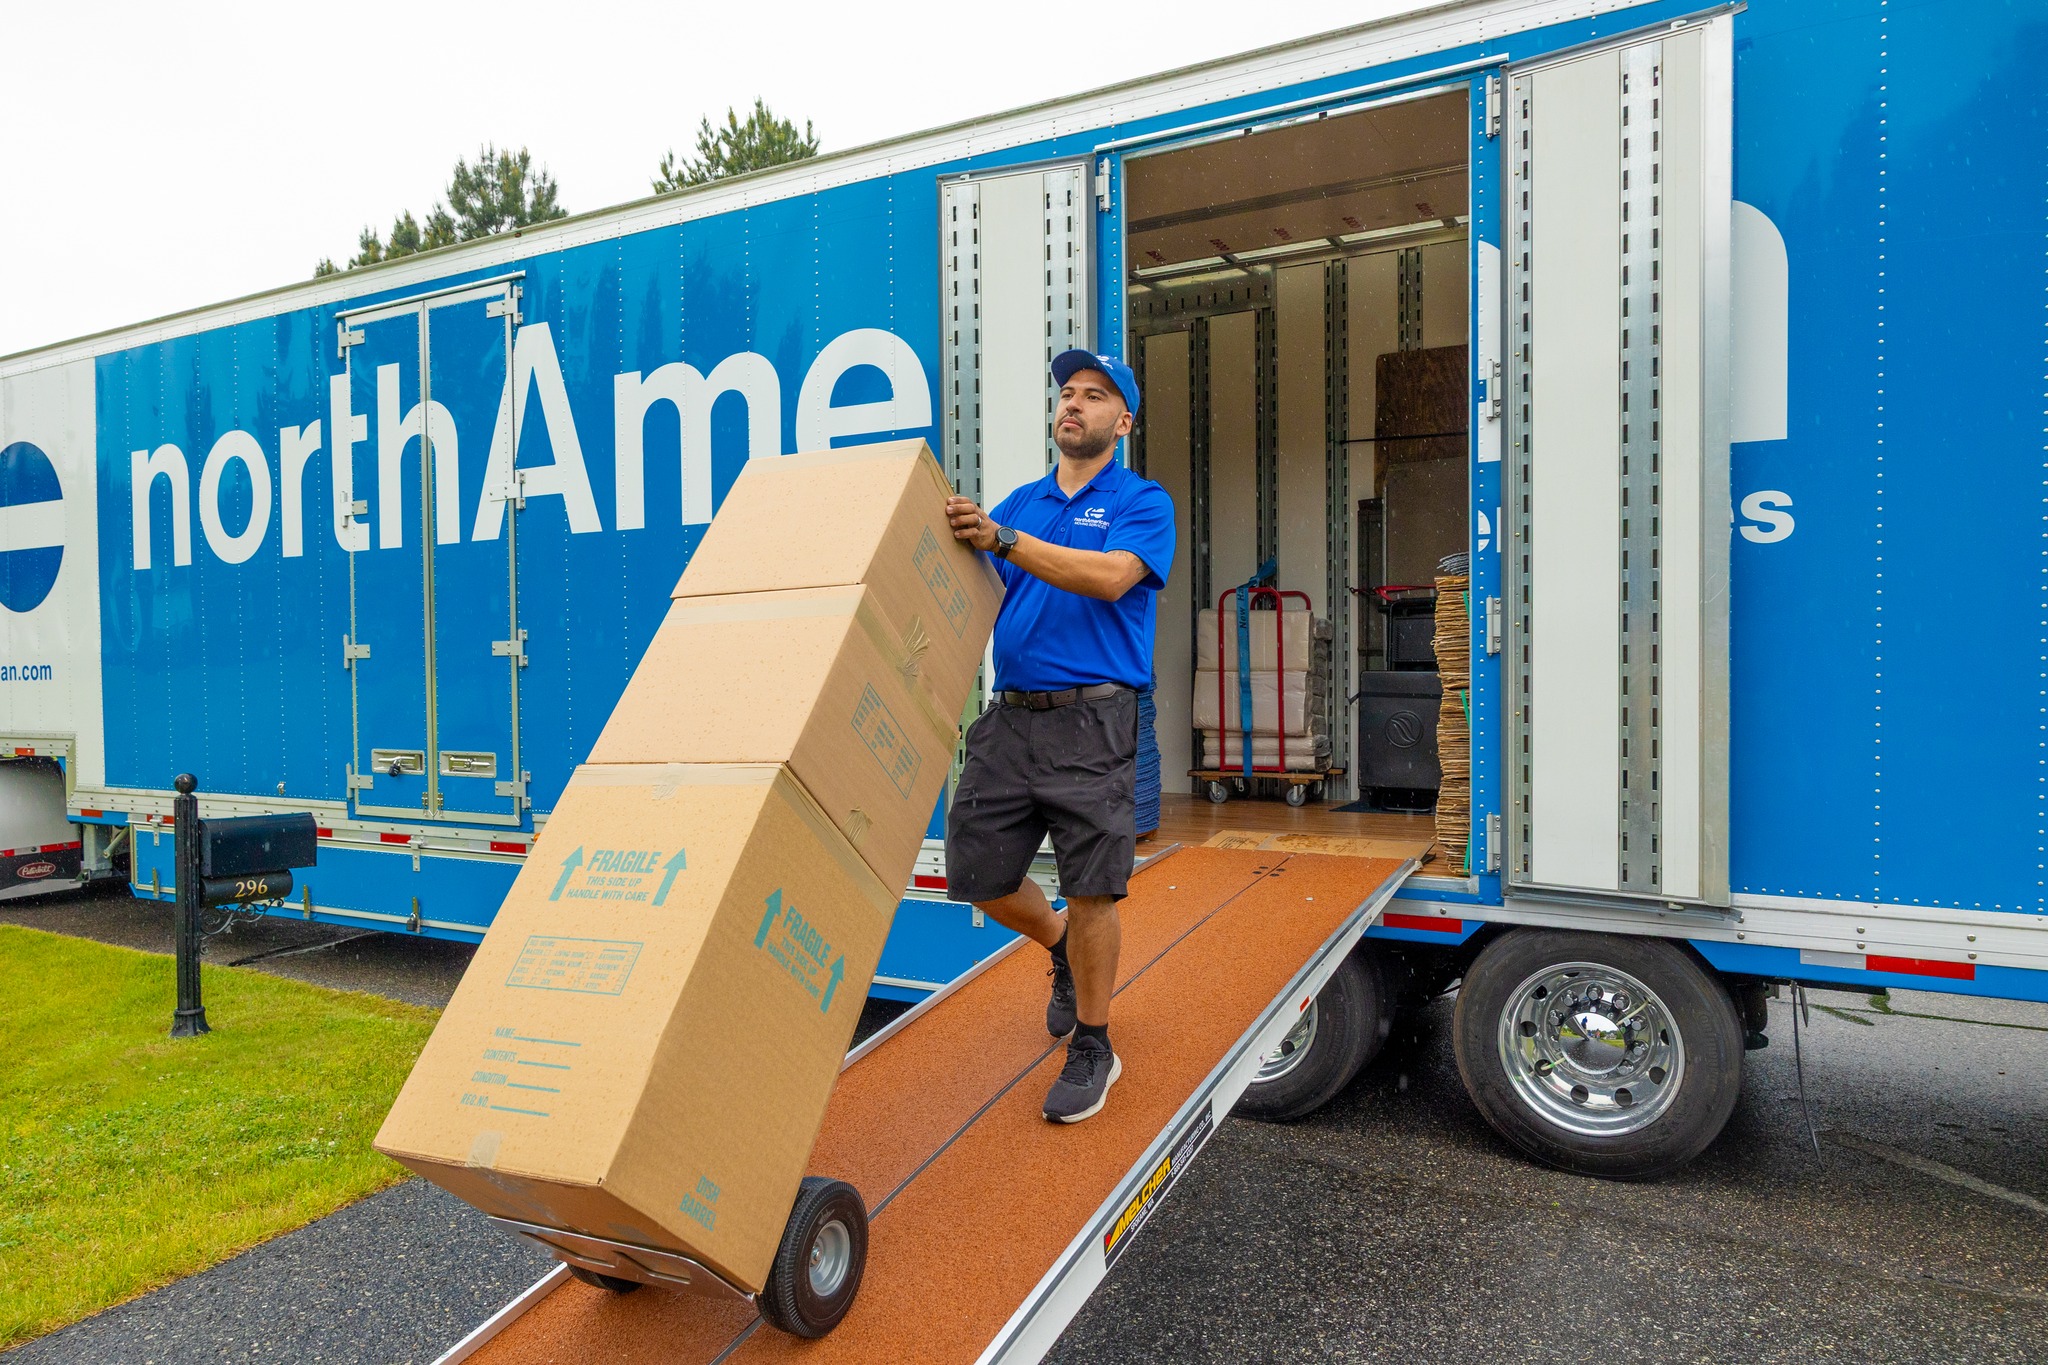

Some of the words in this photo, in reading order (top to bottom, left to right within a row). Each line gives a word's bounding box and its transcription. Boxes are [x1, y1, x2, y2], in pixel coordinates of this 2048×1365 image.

[586, 850, 662, 874] FRAGILE
[235, 878, 268, 898] 296
[586, 876, 606, 886] THIS
[606, 877, 628, 887] SIDE
[628, 878, 642, 888] UP
[566, 889, 601, 899] HANDLE
[601, 889, 624, 900] WITH
[624, 891, 650, 901] CARE
[782, 905, 832, 968] FRAGILE
[495, 1027, 516, 1038] NAME
[482, 1048, 517, 1062] CONTENTS
[471, 1071, 508, 1085] CONDITION
[696, 1175, 720, 1204] DISH
[679, 1192, 716, 1231] BARREL
